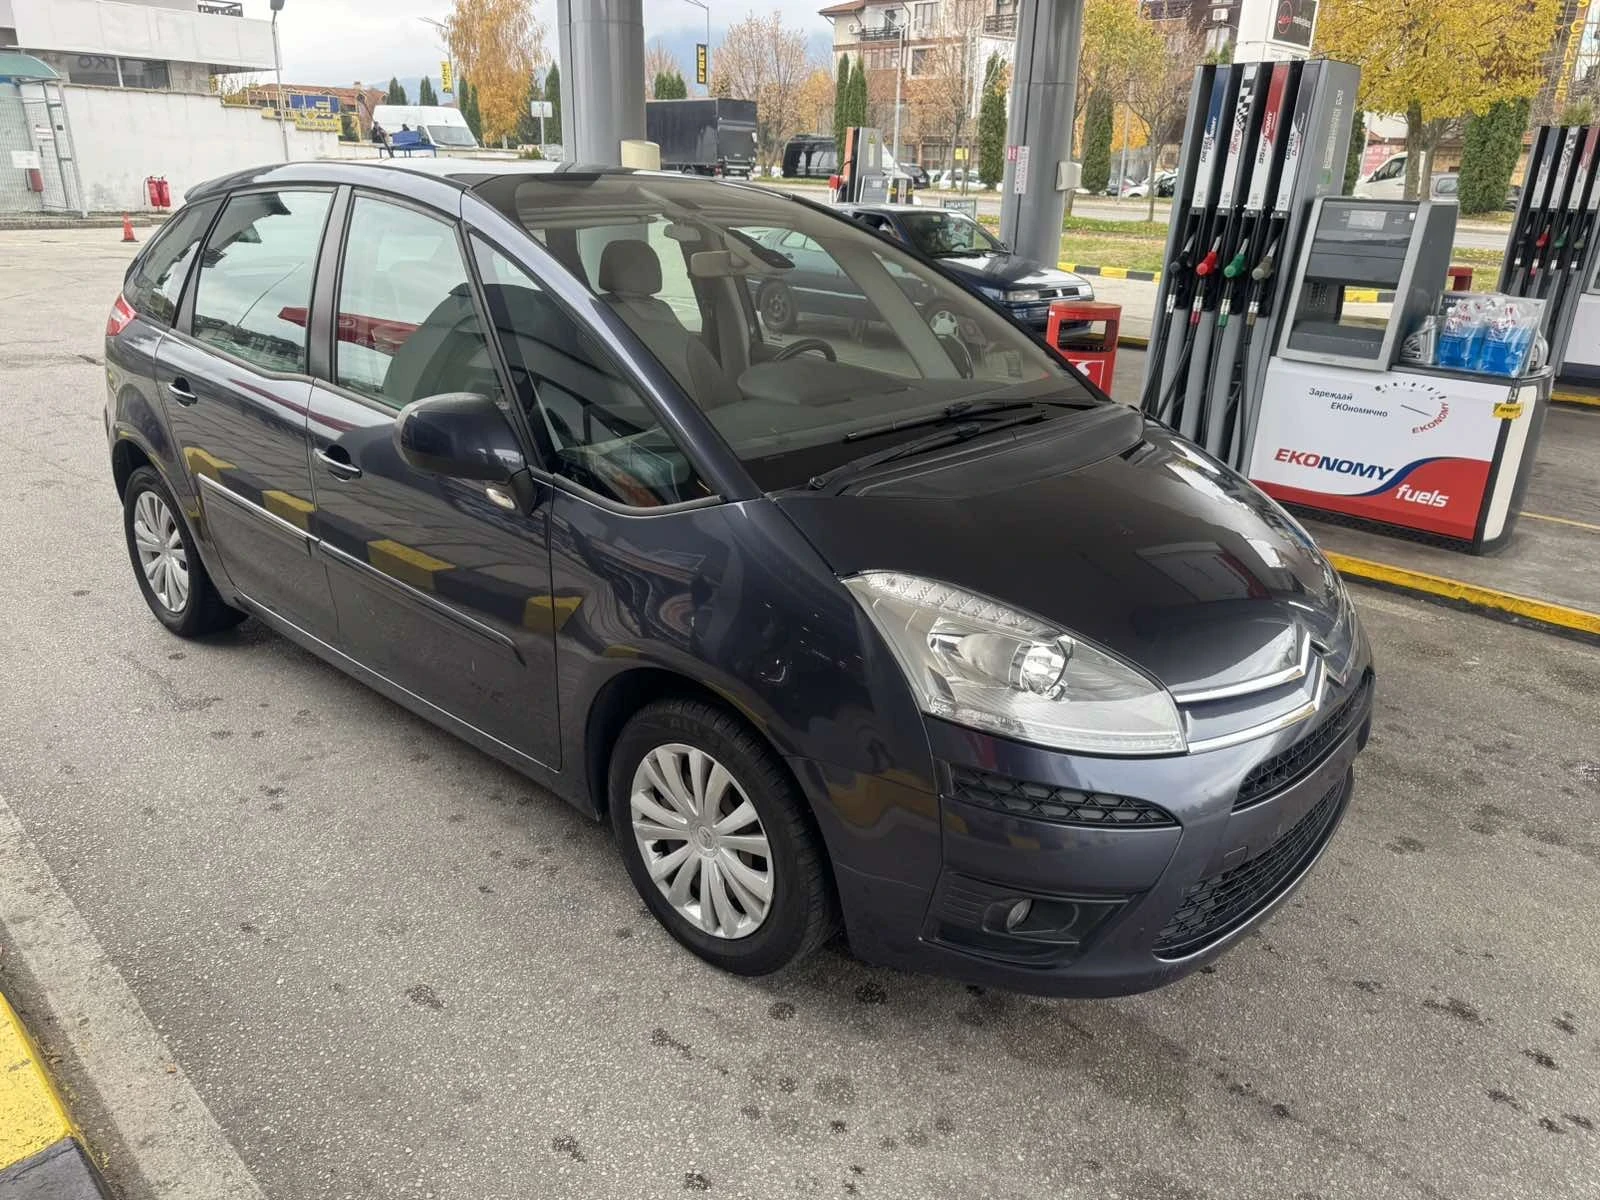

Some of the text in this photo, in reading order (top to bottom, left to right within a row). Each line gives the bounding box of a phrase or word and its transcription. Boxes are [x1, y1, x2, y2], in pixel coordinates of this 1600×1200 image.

[1308, 387, 1353, 401] Зареждай
[1330, 401, 1388, 418] ЕКОномично
[1411, 402, 1449, 434] EKONOMY
[1274, 448, 1394, 480] EKONOMY
[1396, 484, 1449, 508] fuels
